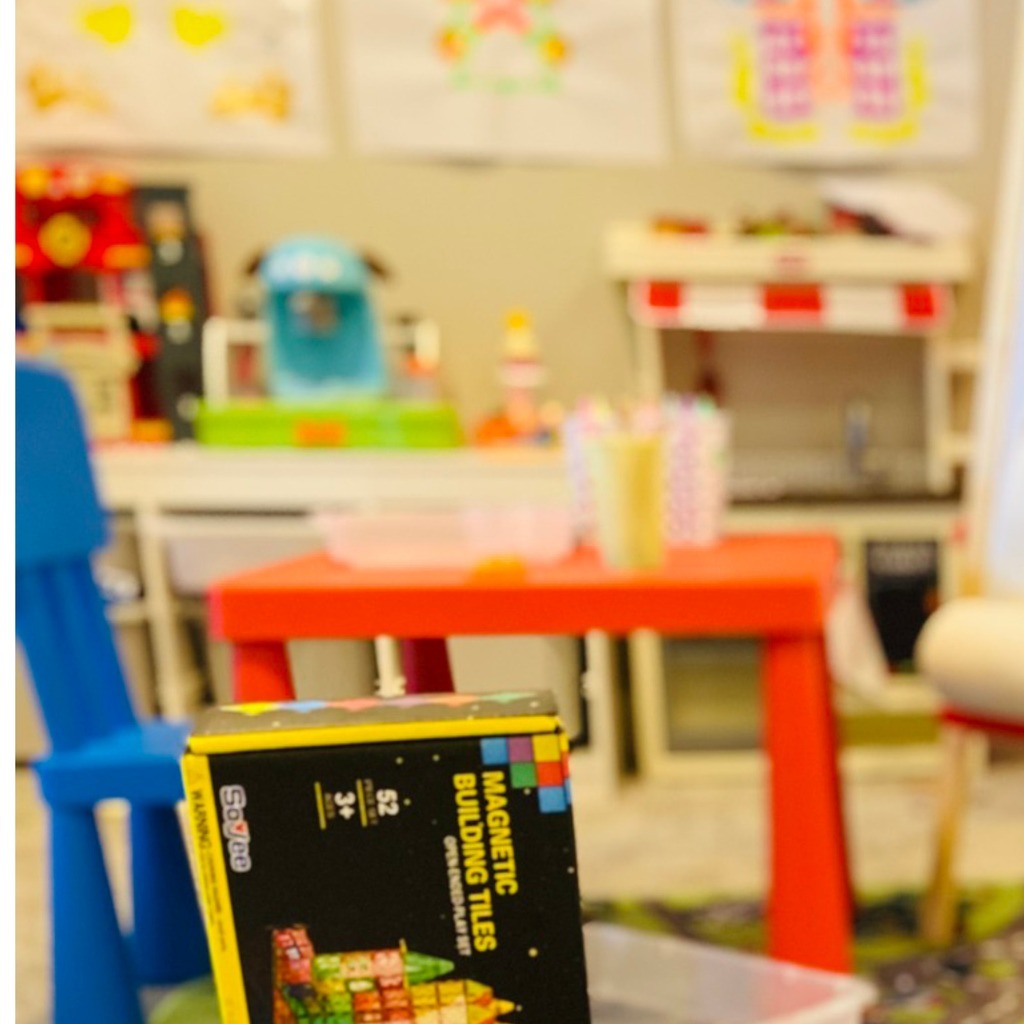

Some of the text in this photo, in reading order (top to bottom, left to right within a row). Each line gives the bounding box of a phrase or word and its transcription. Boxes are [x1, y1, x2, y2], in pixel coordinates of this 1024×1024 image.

[334, 791, 356, 820] 3+
[376, 788, 400, 817] 52
[481, 770, 519, 895] MAGNETIC
[453, 772, 497, 952] BUILDING TILES
